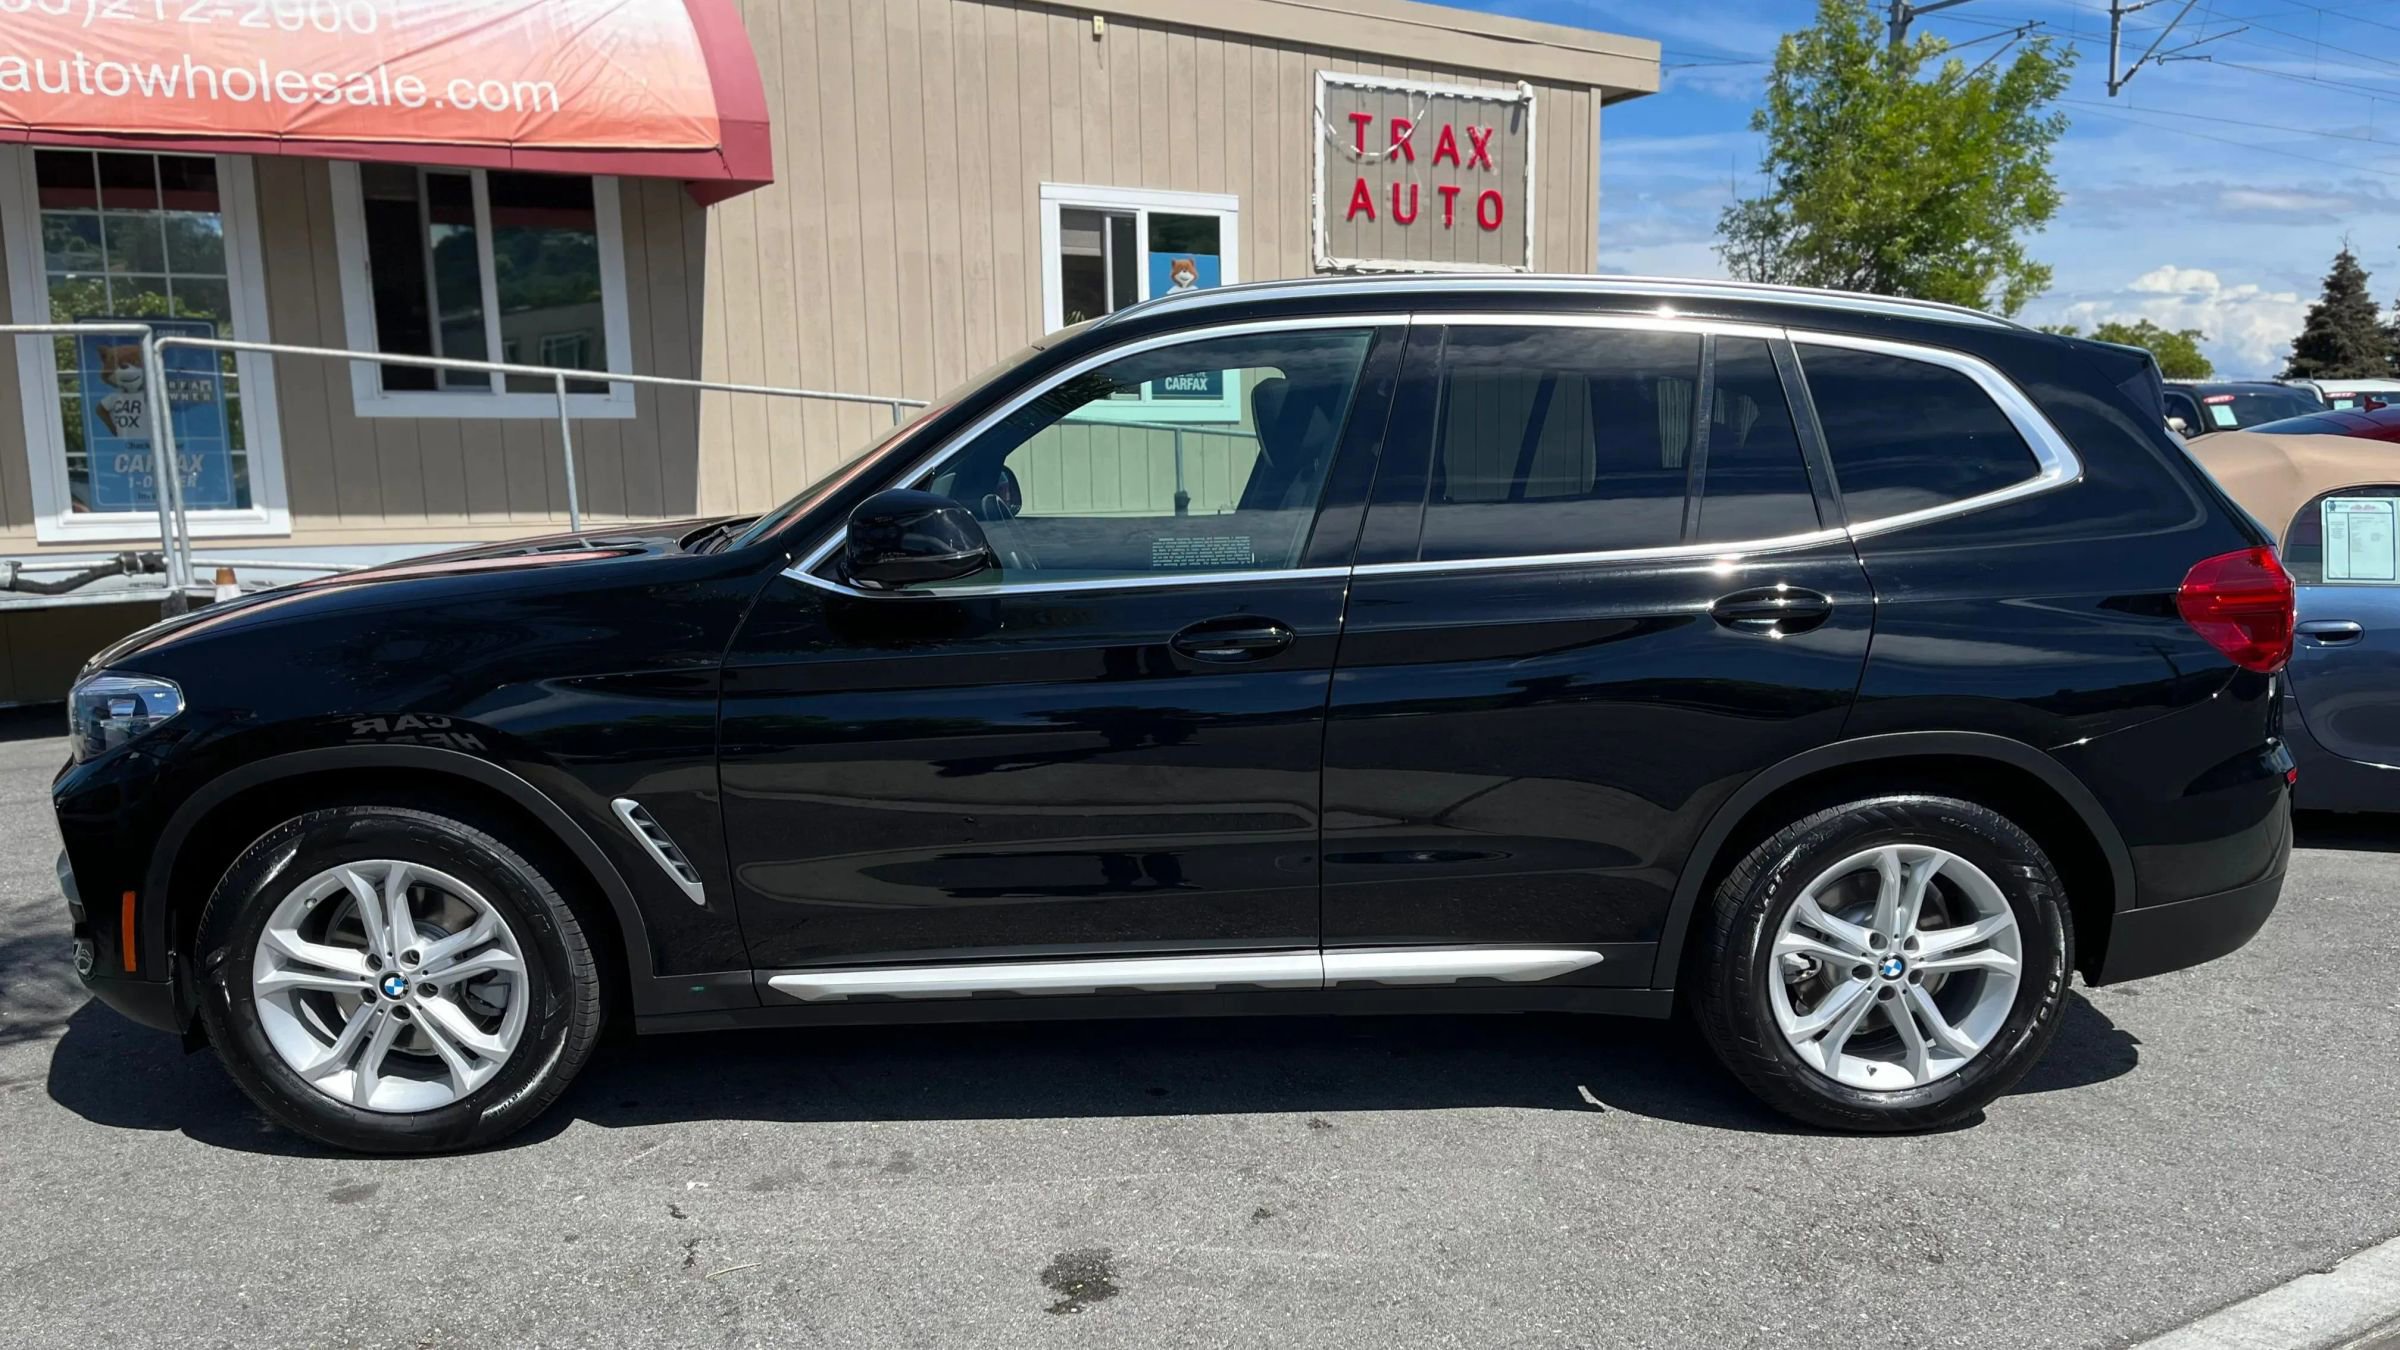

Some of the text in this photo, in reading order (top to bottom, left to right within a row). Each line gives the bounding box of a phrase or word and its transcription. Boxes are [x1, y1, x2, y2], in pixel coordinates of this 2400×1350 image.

[0, 51, 560, 112] autowholesale.com
[1349, 113, 1493, 169] TRAX
[1346, 177, 1504, 231] AUTO
[1165, 377, 1208, 391] CARFAX
[113, 400, 141, 414] CAR
[114, 454, 205, 474] CAAX
[128, 475, 198, 489] 1-OER
